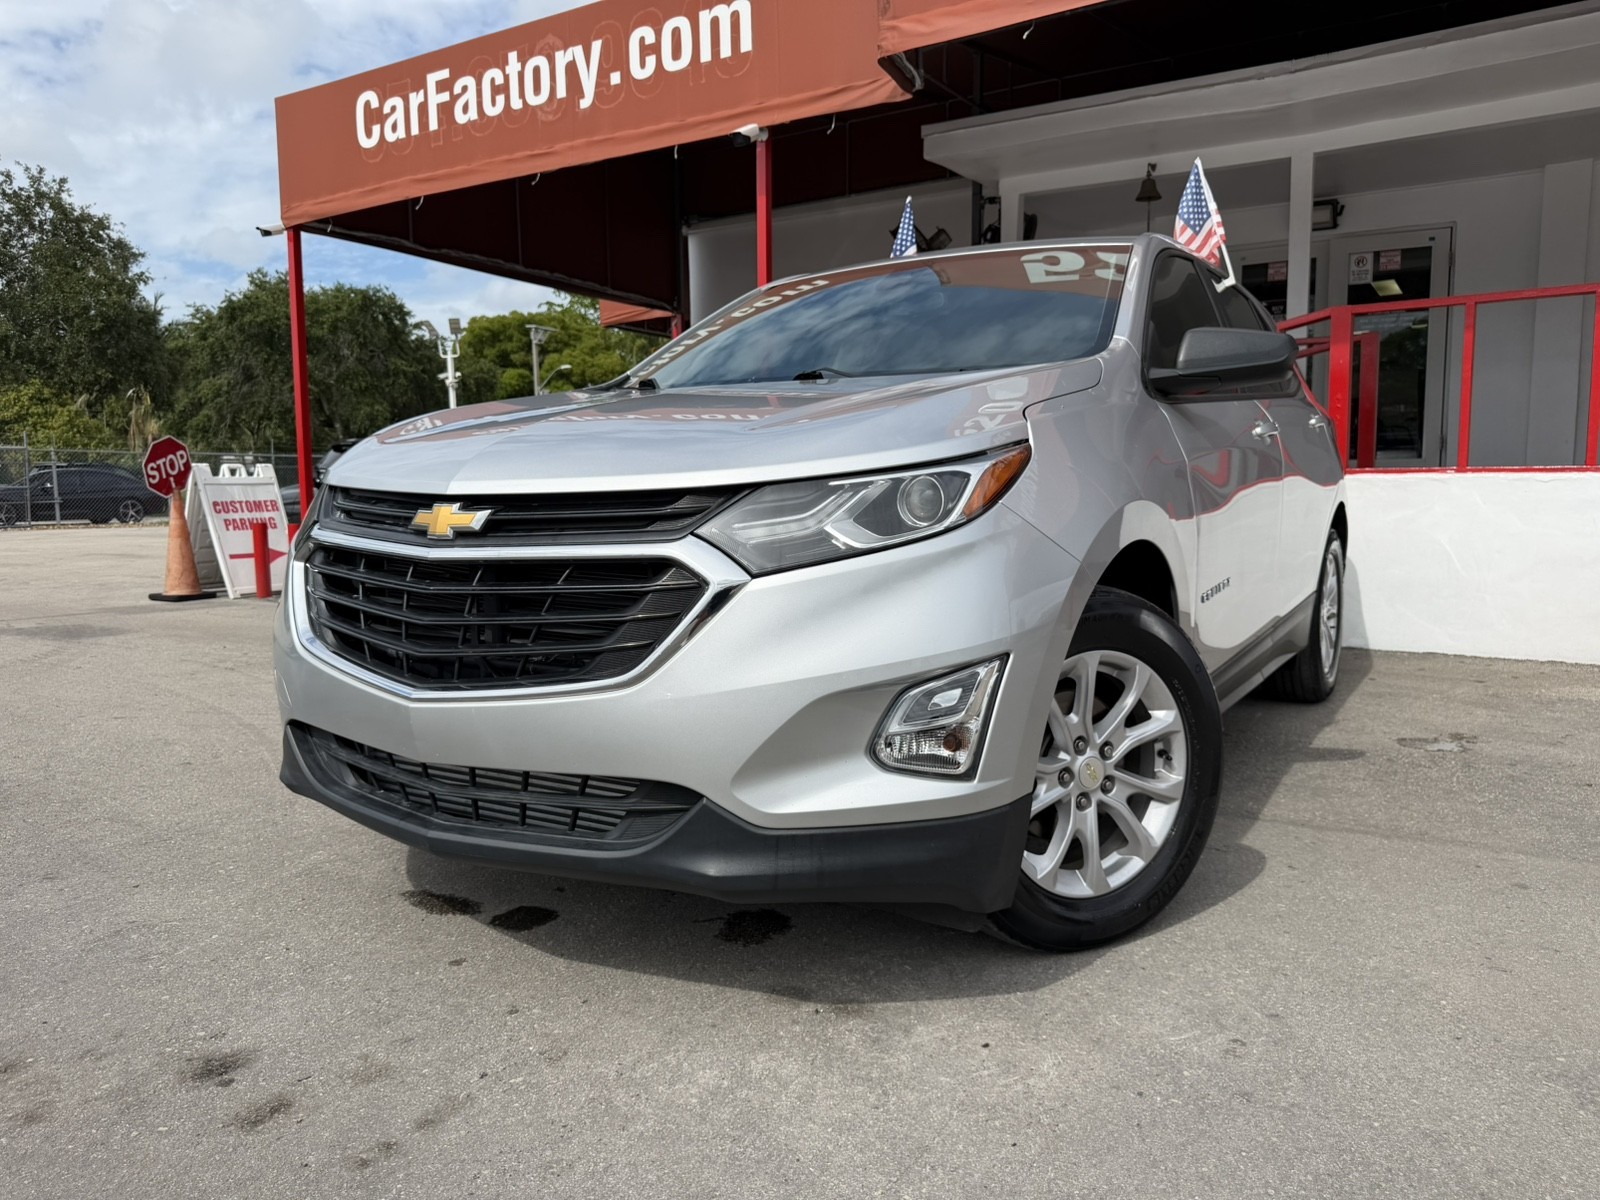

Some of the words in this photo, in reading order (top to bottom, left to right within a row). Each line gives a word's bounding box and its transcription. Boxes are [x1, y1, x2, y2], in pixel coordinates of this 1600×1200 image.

[355, 0, 753, 149] CarFactory.com
[147, 450, 187, 484] STOP
[212, 499, 279, 514] CUSTOMER
